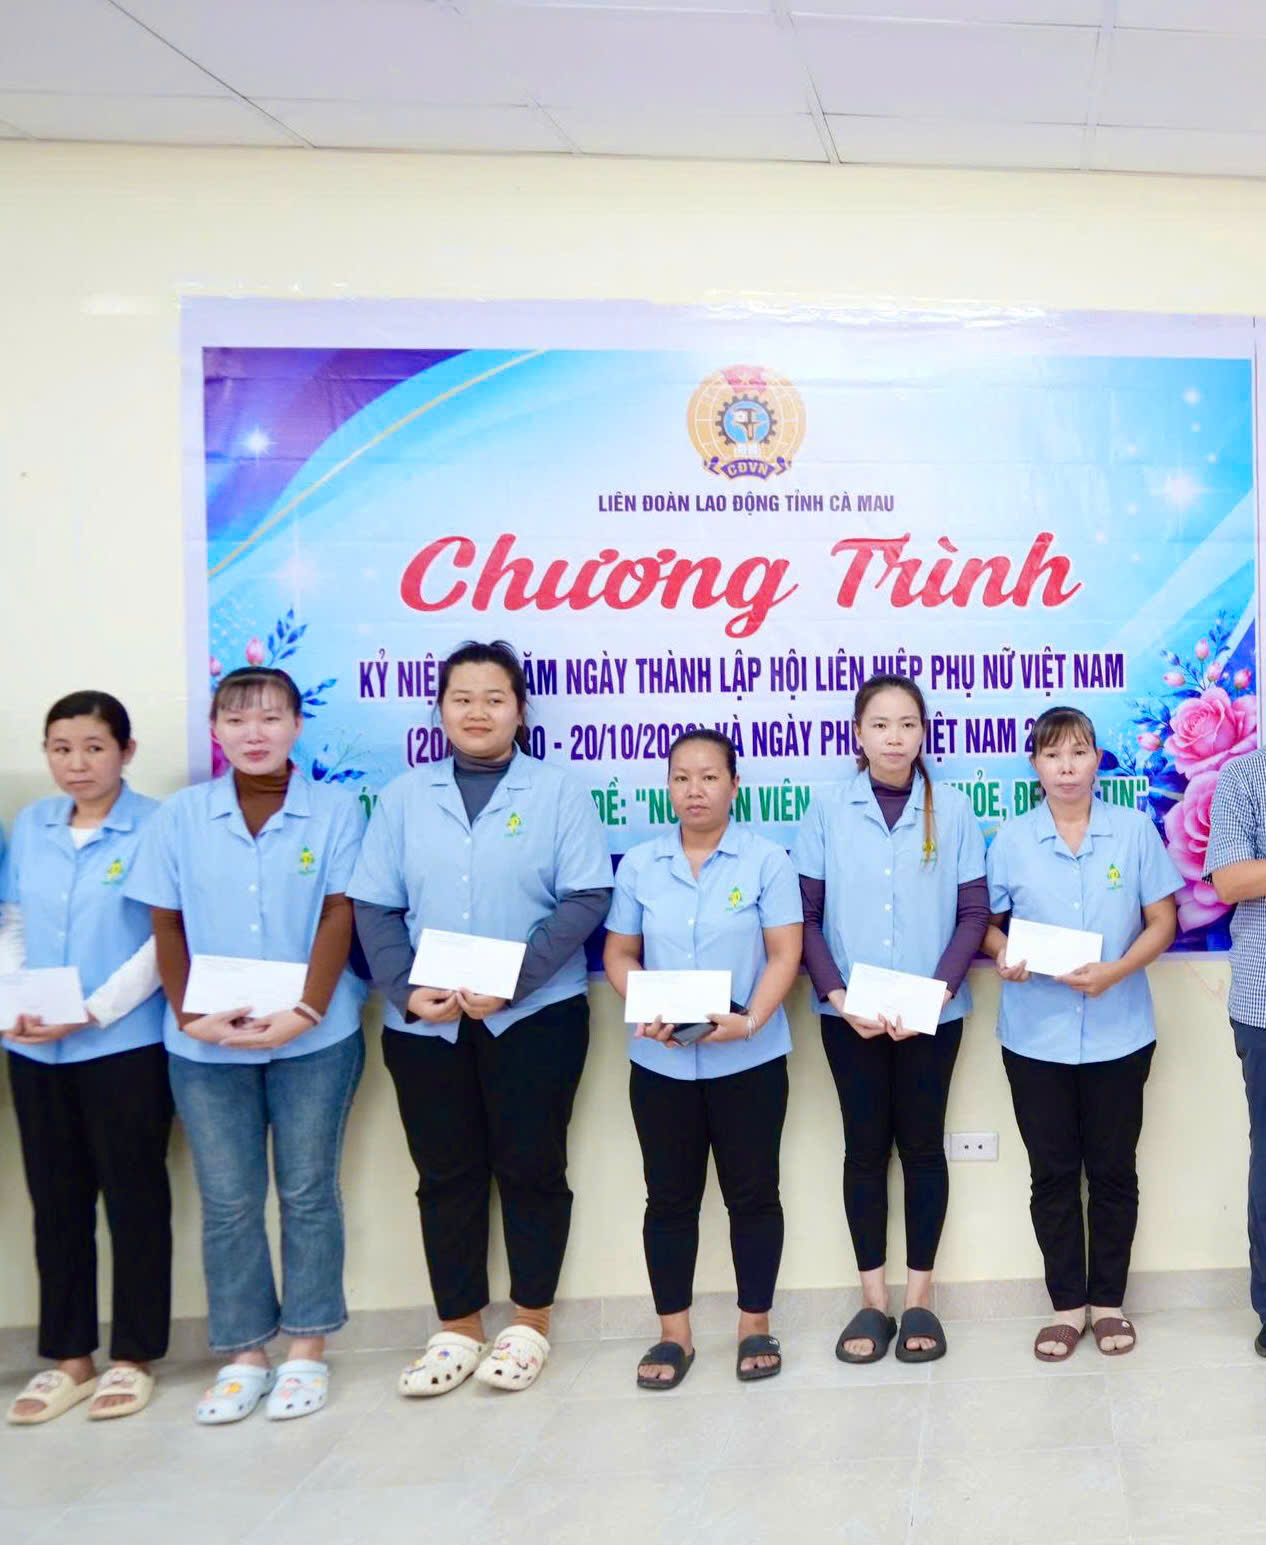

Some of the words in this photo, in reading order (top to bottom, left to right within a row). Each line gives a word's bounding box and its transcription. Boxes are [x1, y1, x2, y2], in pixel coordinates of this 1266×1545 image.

[599, 491, 636, 512] LIÊN
[642, 491, 690, 512] ĐOÀN
[696, 495, 727, 512] LAO
[732, 491, 779, 516] ĐỘNG
[785, 489, 824, 512] TỈNH
[829, 491, 852, 512] CÀ
[857, 494, 894, 512] MAU
[399, 532, 799, 639] Chương
[829, 531, 1082, 608] Trình
[359, 648, 388, 698] KỶ
[397, 652, 449, 706] NIỆ
[566, 650, 628, 695] NGÀY
[636, 649, 711, 694] THÀNH
[720, 649, 762, 701] LẬP
[771, 649, 807, 702] HỘI
[816, 648, 864, 692] LIÊN
[931, 654, 975, 698] PHỤ
[983, 648, 1016, 689] NỮ
[1022, 645, 1066, 697] VIỆT
[1074, 652, 1124, 689] NAM
[752, 713, 812, 757] NGÀY
[965, 717, 1016, 754] NAM
[758, 778, 810, 822] VIÊN
